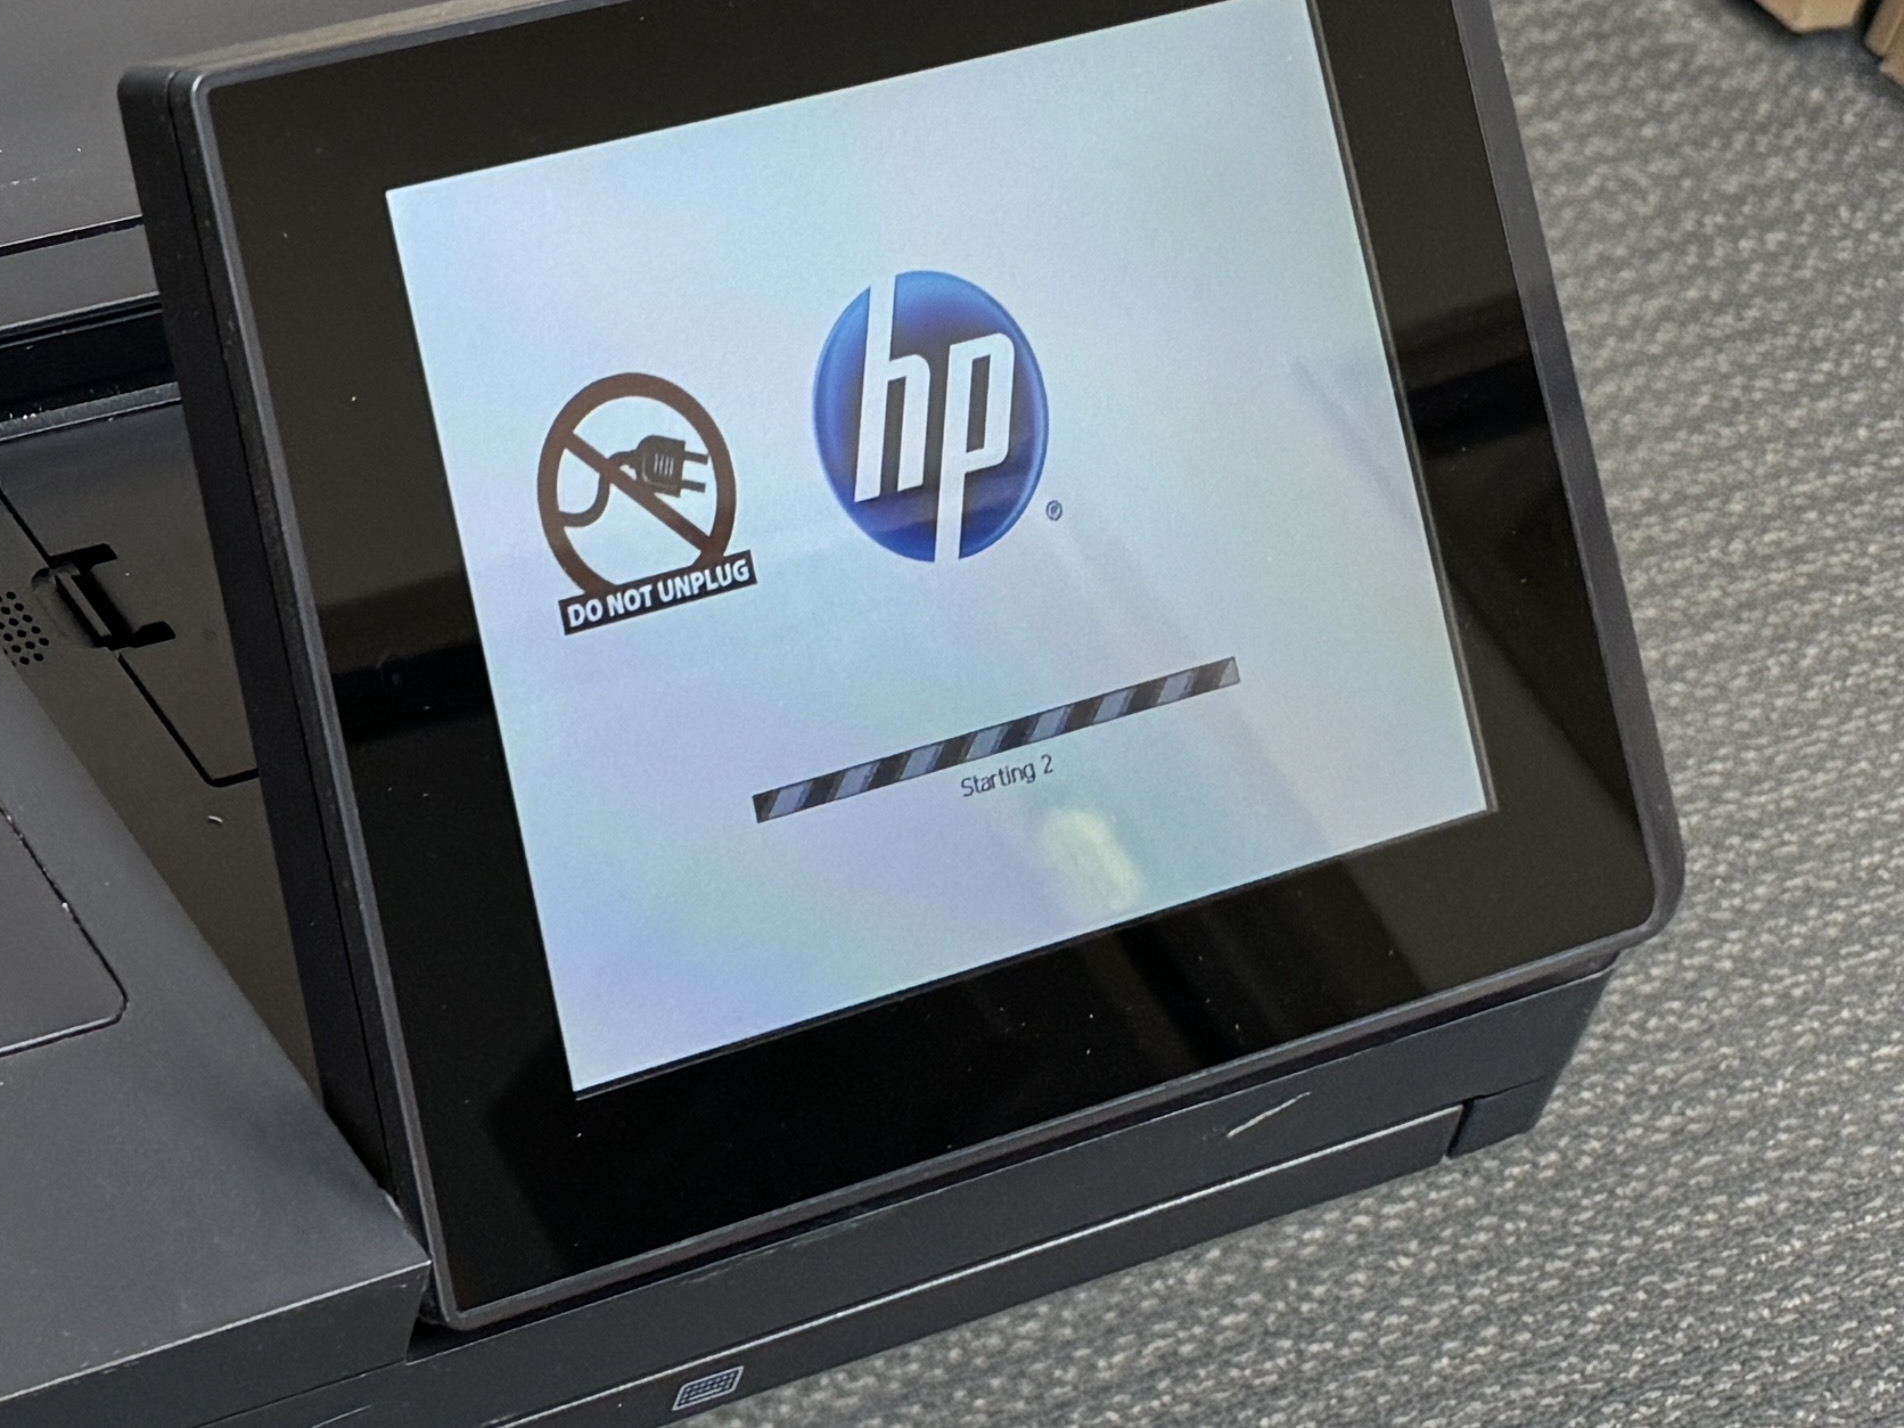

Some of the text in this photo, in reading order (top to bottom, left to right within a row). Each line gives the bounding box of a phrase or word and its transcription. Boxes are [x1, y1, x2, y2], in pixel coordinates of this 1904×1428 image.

[853, 273, 1016, 563] hp
[566, 558, 751, 628] DO NOT UNPLUG
[960, 753, 1054, 797] Starting 2
